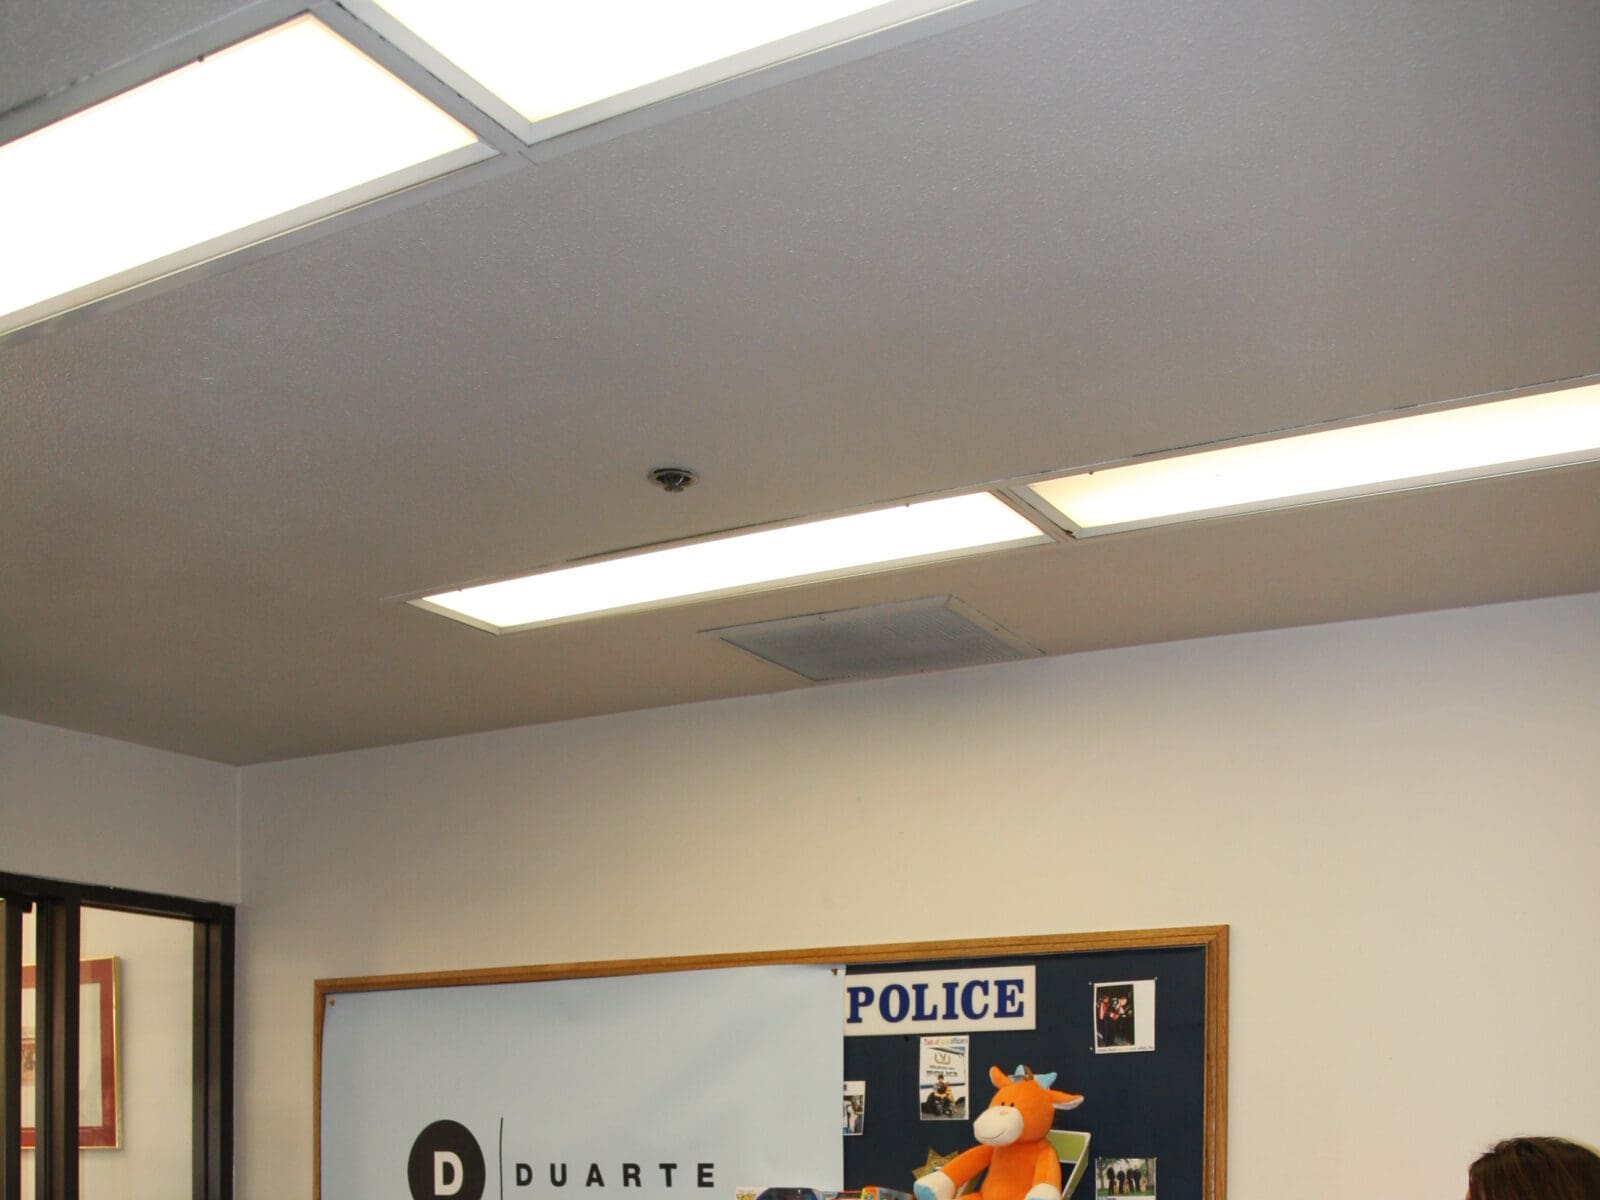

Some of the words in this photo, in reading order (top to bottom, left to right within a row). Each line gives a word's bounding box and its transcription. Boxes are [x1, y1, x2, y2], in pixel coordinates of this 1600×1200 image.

[846, 978, 1025, 1024] POLICE
[432, 1150, 464, 1196] D
[515, 1162, 715, 1188] DUARTE
